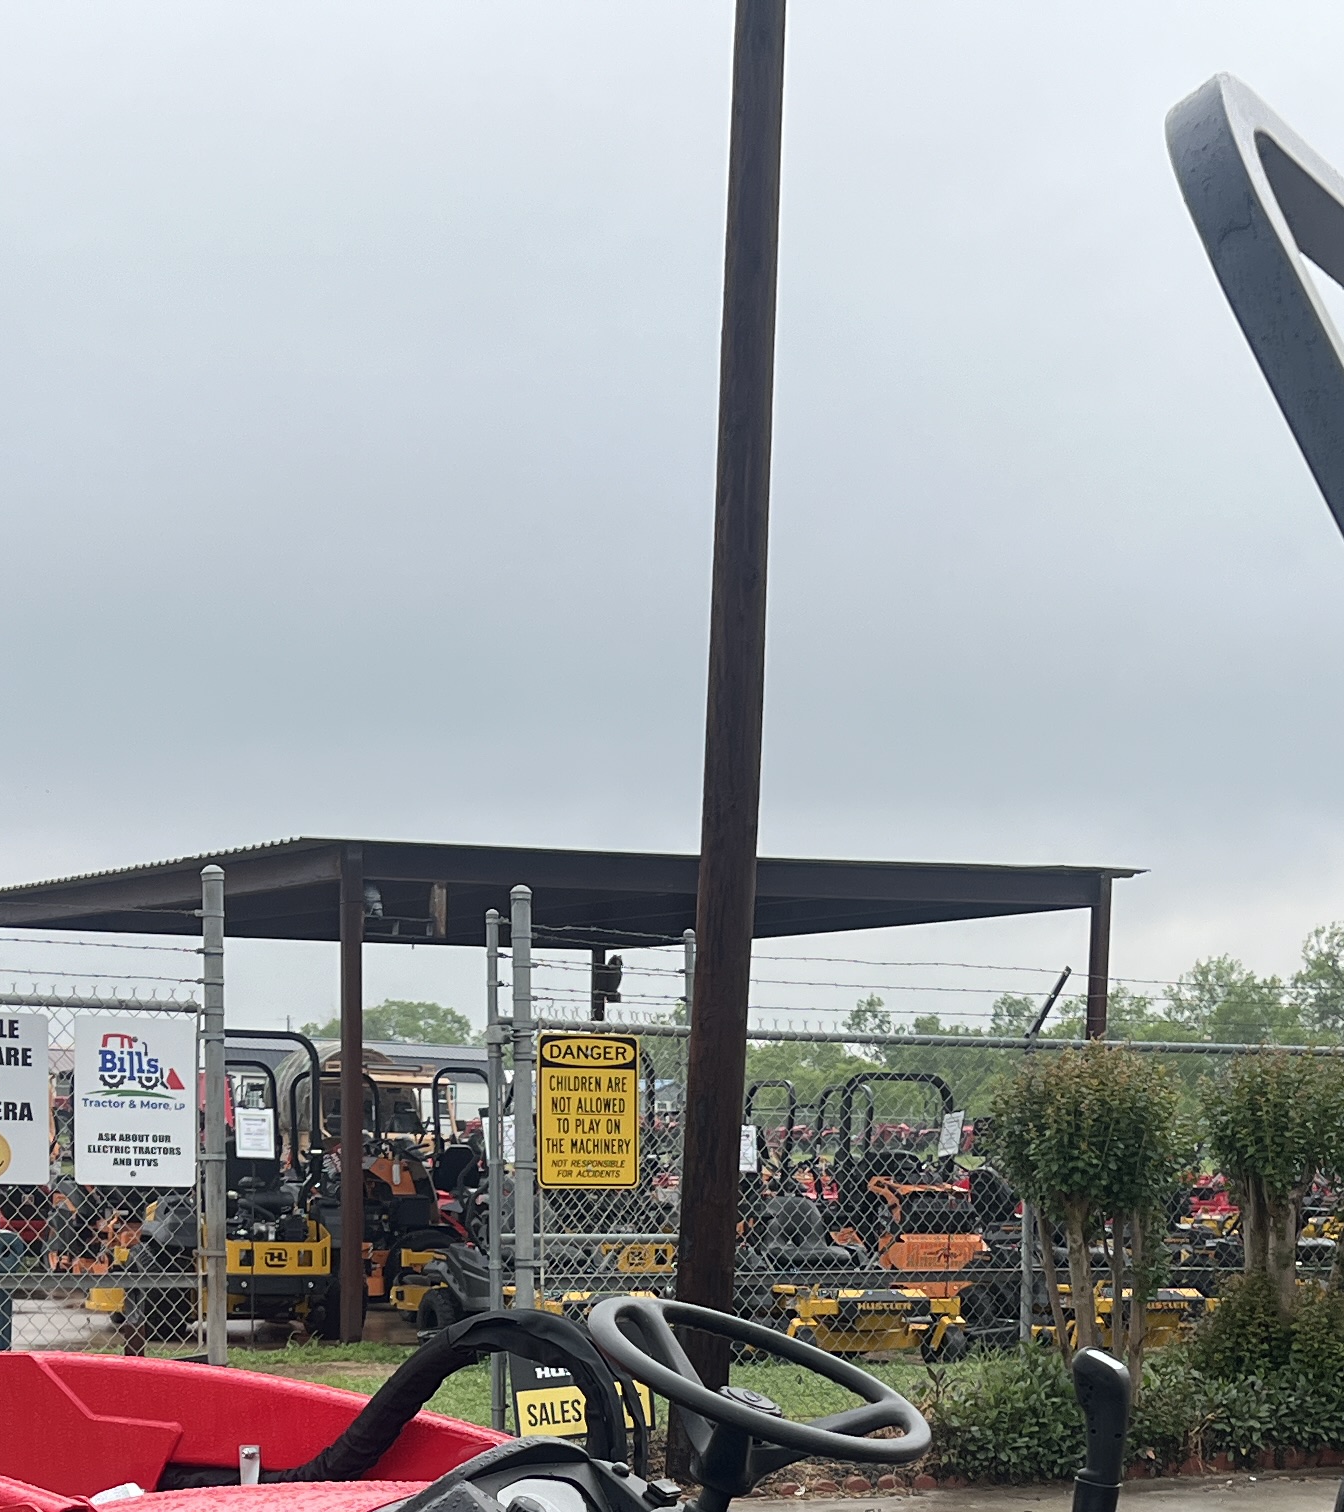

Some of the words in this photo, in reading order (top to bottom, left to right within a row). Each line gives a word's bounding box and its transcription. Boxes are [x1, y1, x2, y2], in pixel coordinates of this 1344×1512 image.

[549, 1044, 627, 1061] DANGER
[549, 1075, 601, 1092] CHILDREN
[606, 1077, 627, 1093] ARE
[82, 1098, 125, 1109] Tractor
[128, 1099, 136, 1109] &
[552, 1097, 571, 1114] NOT
[576, 1097, 625, 1114] ALLOWED
[557, 1118, 569, 1134] TO
[575, 1118, 601, 1134] PLAY
[606, 1118, 621, 1134] ON
[97, 1133, 116, 1141] ASK
[119, 1134, 150, 1142] ABOUT
[151, 1134, 171, 1143] OUR
[87, 1145, 131, 1154] ELECTRIC
[132, 1146, 181, 1155] TRACTORS
[546, 1138, 565, 1154] THE
[570, 1138, 631, 1155] MACHINERY
[112, 1158, 132, 1166] AND
[134, 1158, 158, 1167] UTVS
[551, 1159, 568, 1168] NOT
[570, 1159, 626, 1169] RESPONSIBLE
[556, 1169, 573, 1178] FOR
[576, 1169, 621, 1178] ACCIDENTS
[527, 1399, 582, 1427] SALES
